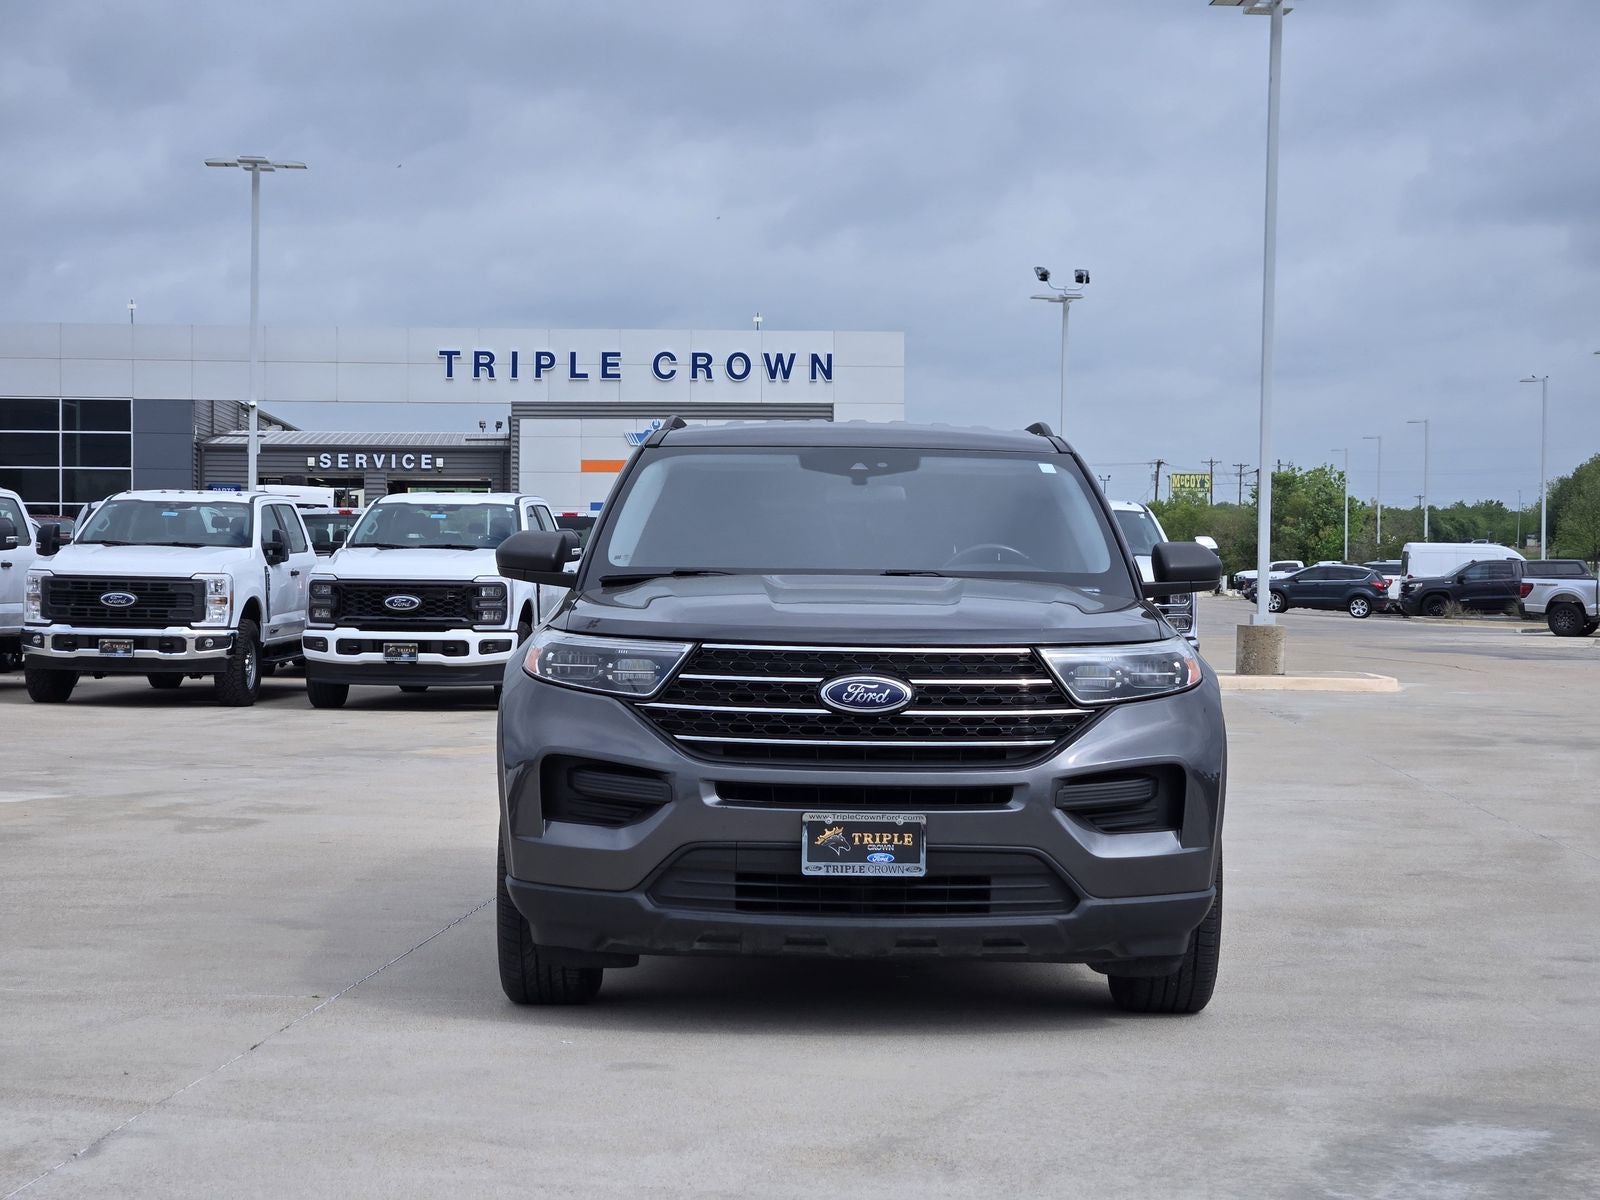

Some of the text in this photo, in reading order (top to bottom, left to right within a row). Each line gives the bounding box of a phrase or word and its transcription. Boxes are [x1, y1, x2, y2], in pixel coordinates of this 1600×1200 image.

[438, 350, 834, 382] TRIPLE CROWN
[319, 453, 432, 469] SERVICE
[842, 683, 890, 702] Ford
[852, 833, 912, 845] TRIPLE
[823, 865, 865, 873] TRIPLE
[867, 866, 905, 874] CROWN
